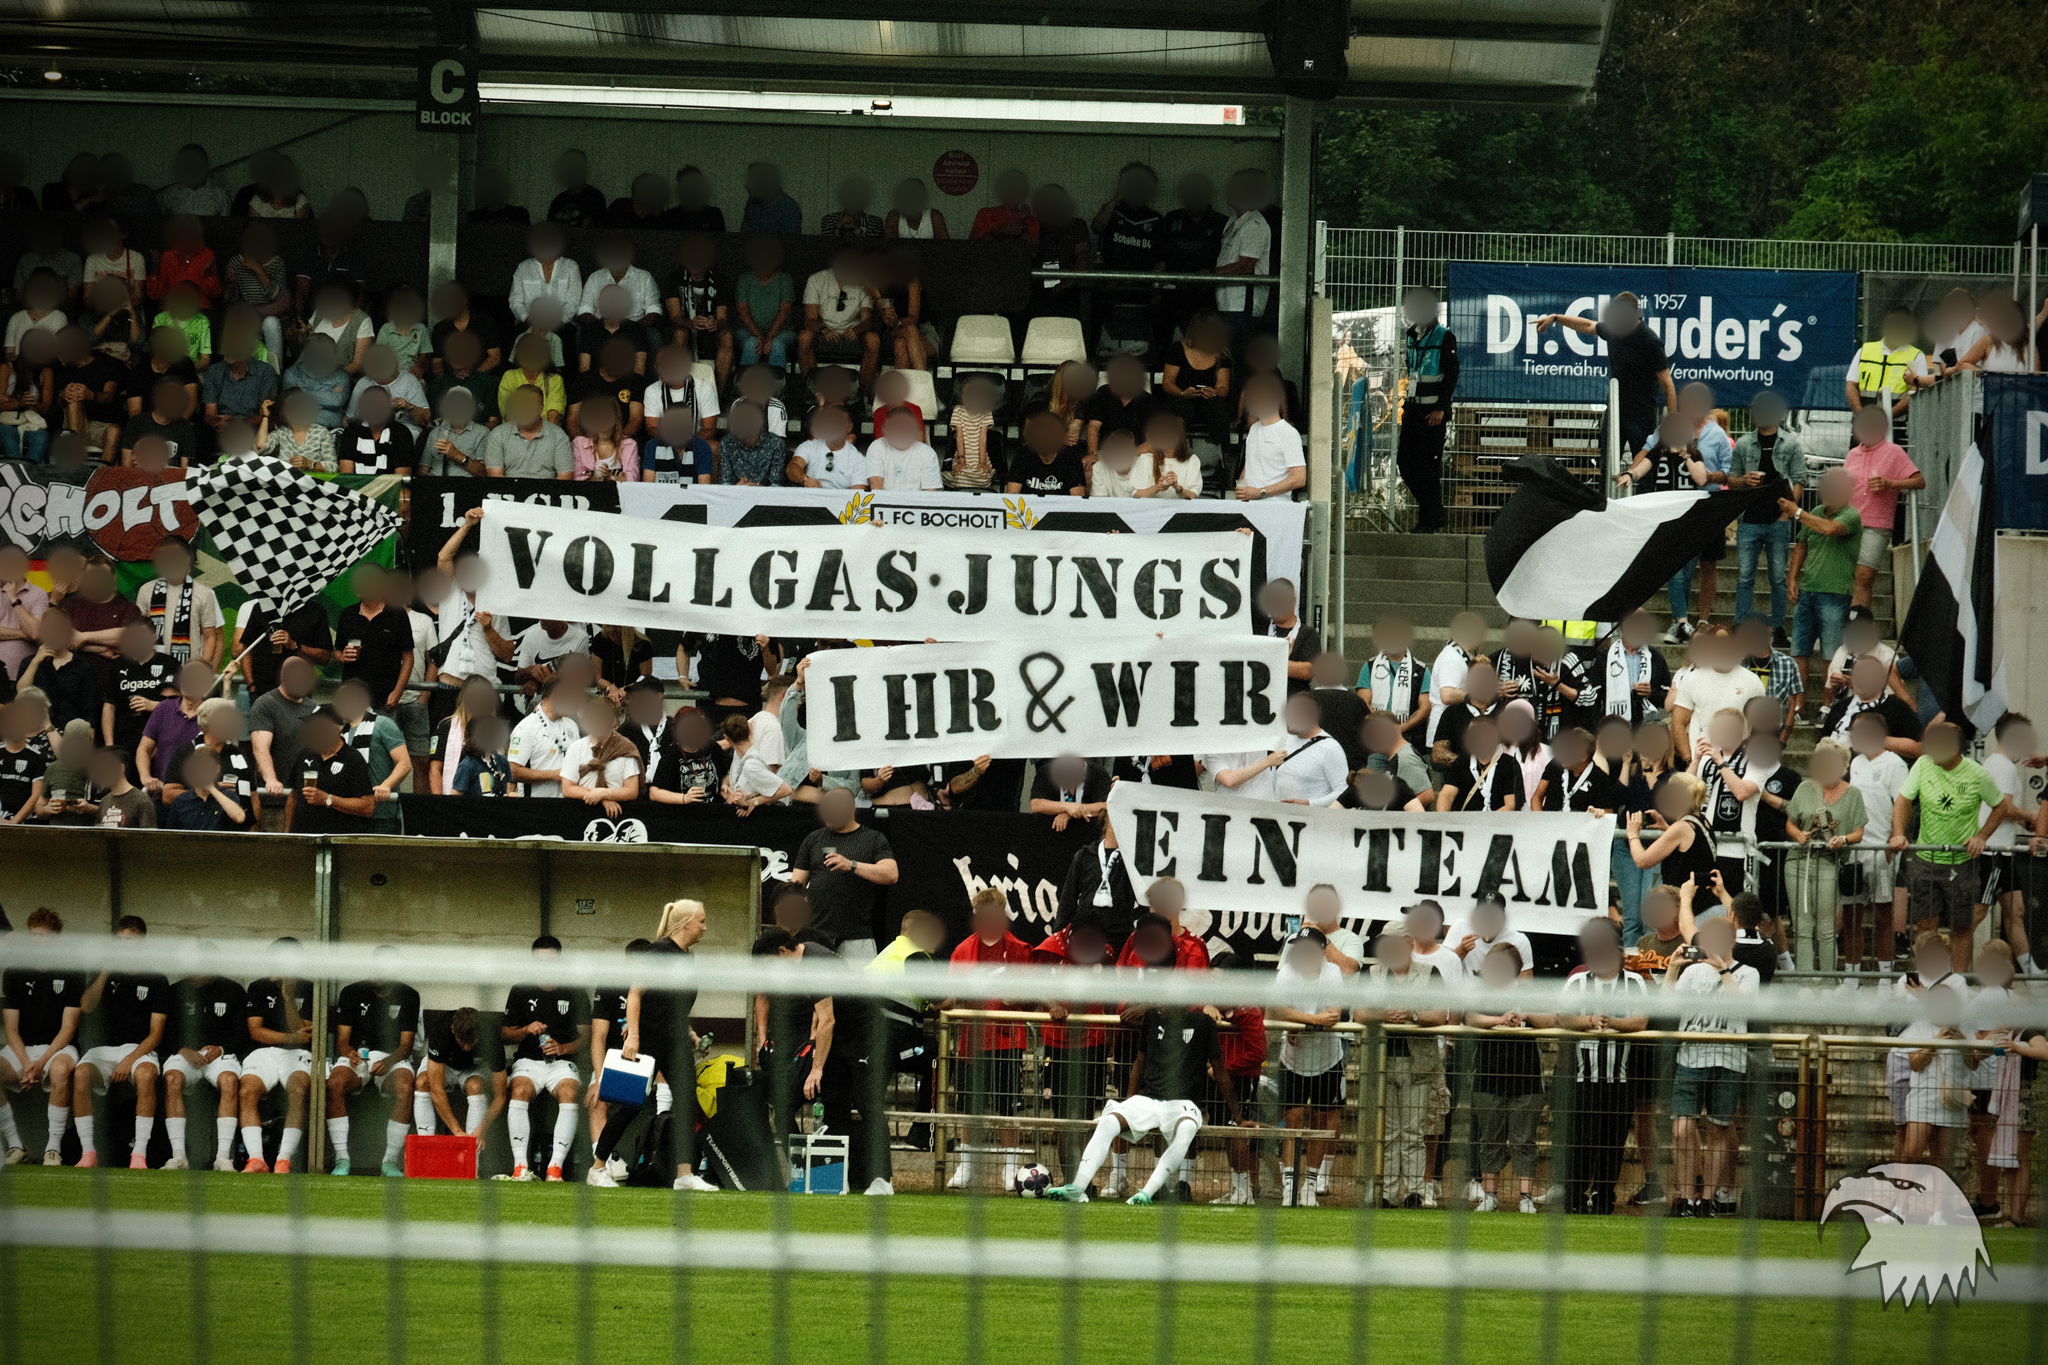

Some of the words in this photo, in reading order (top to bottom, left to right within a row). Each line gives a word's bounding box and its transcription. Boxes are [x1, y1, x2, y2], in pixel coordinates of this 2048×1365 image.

[430, 59, 466, 104] C
[421, 110, 472, 125] BLOCK
[1113, 232, 1141, 247] Schalke
[1142, 239, 1152, 249] 04
[1635, 294, 1648, 309] eit
[1653, 294, 1688, 310] 1957
[1523, 359, 1608, 377] Tierernähru
[893, 510, 916, 526] FC
[921, 512, 999, 529] BOCHOLT
[120, 679, 161, 692] Gigaset
[829, 668, 1002, 743] IHR
[1019, 651, 1075, 734] &
[1090, 660, 1277, 728] WIR
[1132, 808, 1307, 888] EIN
[1353, 827, 1598, 910] TEAM
